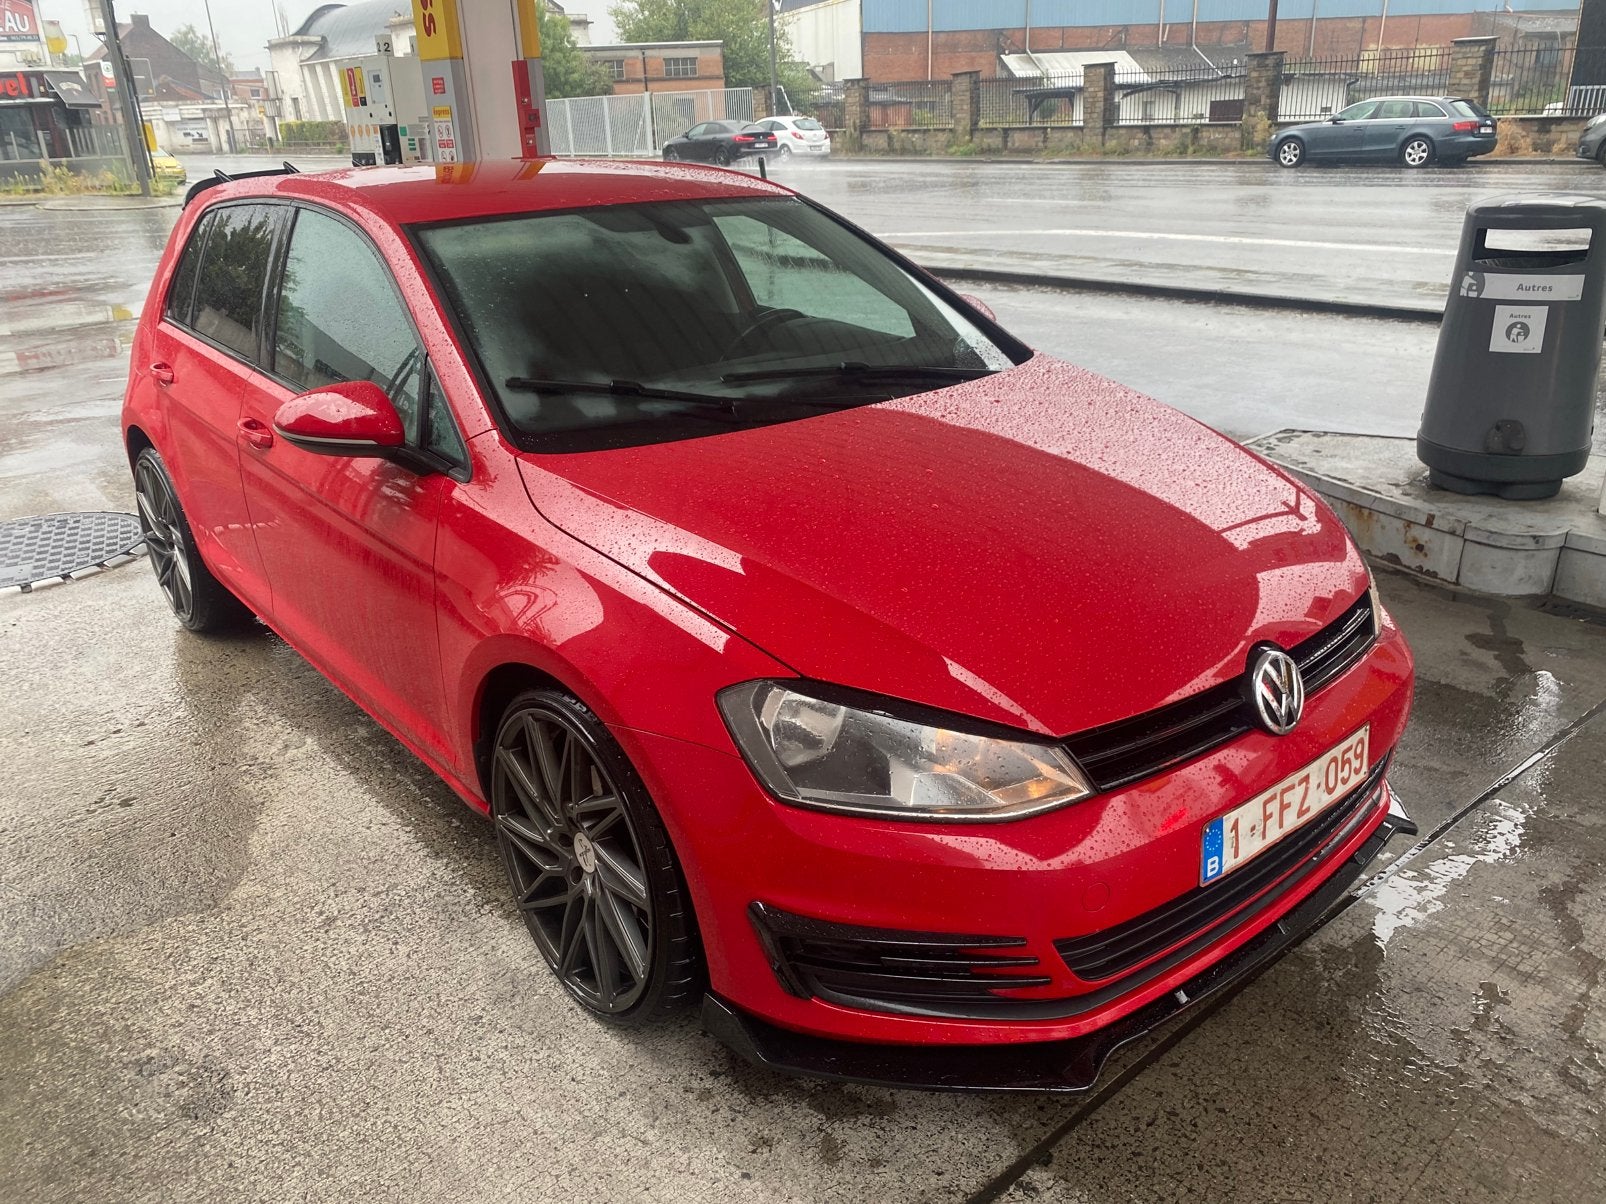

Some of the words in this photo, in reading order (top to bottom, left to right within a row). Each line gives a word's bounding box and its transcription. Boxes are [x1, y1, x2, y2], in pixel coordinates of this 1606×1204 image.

[0, 10, 30, 32] AU
[383, 42, 391, 52] 2
[0, 71, 29, 96] el
[1516, 283, 1553, 292] Autres
[1207, 855, 1219, 877] B
